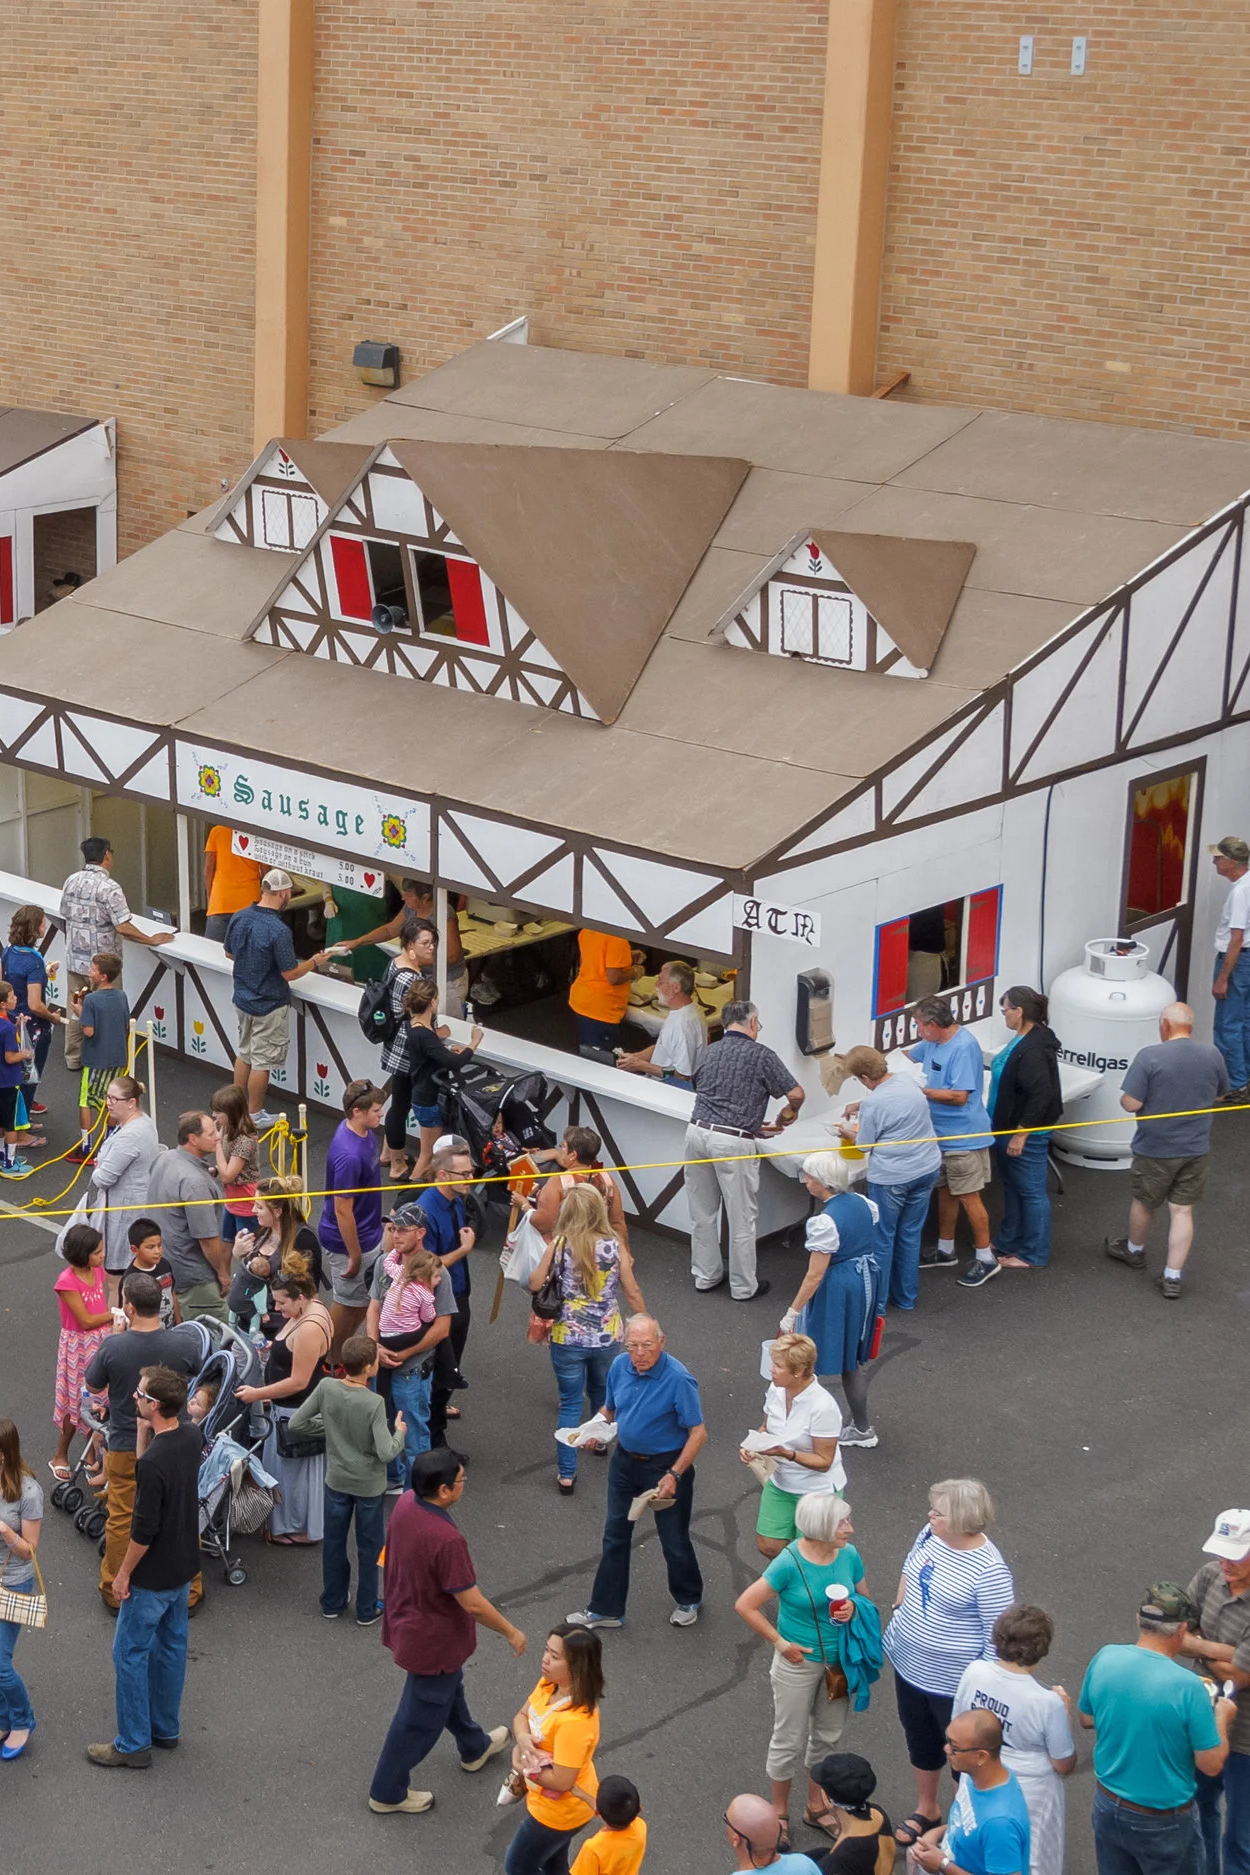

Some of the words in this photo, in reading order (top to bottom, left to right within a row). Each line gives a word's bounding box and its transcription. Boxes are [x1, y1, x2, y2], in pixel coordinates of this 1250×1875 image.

[233, 774, 365, 836] Sausage
[304, 867, 324, 879] kraut
[338, 861, 355, 872] 5.00
[742, 899, 815, 946] ATM
[1056, 1046, 1129, 1074] errellgas
[974, 1689, 1010, 1718] PROUD
